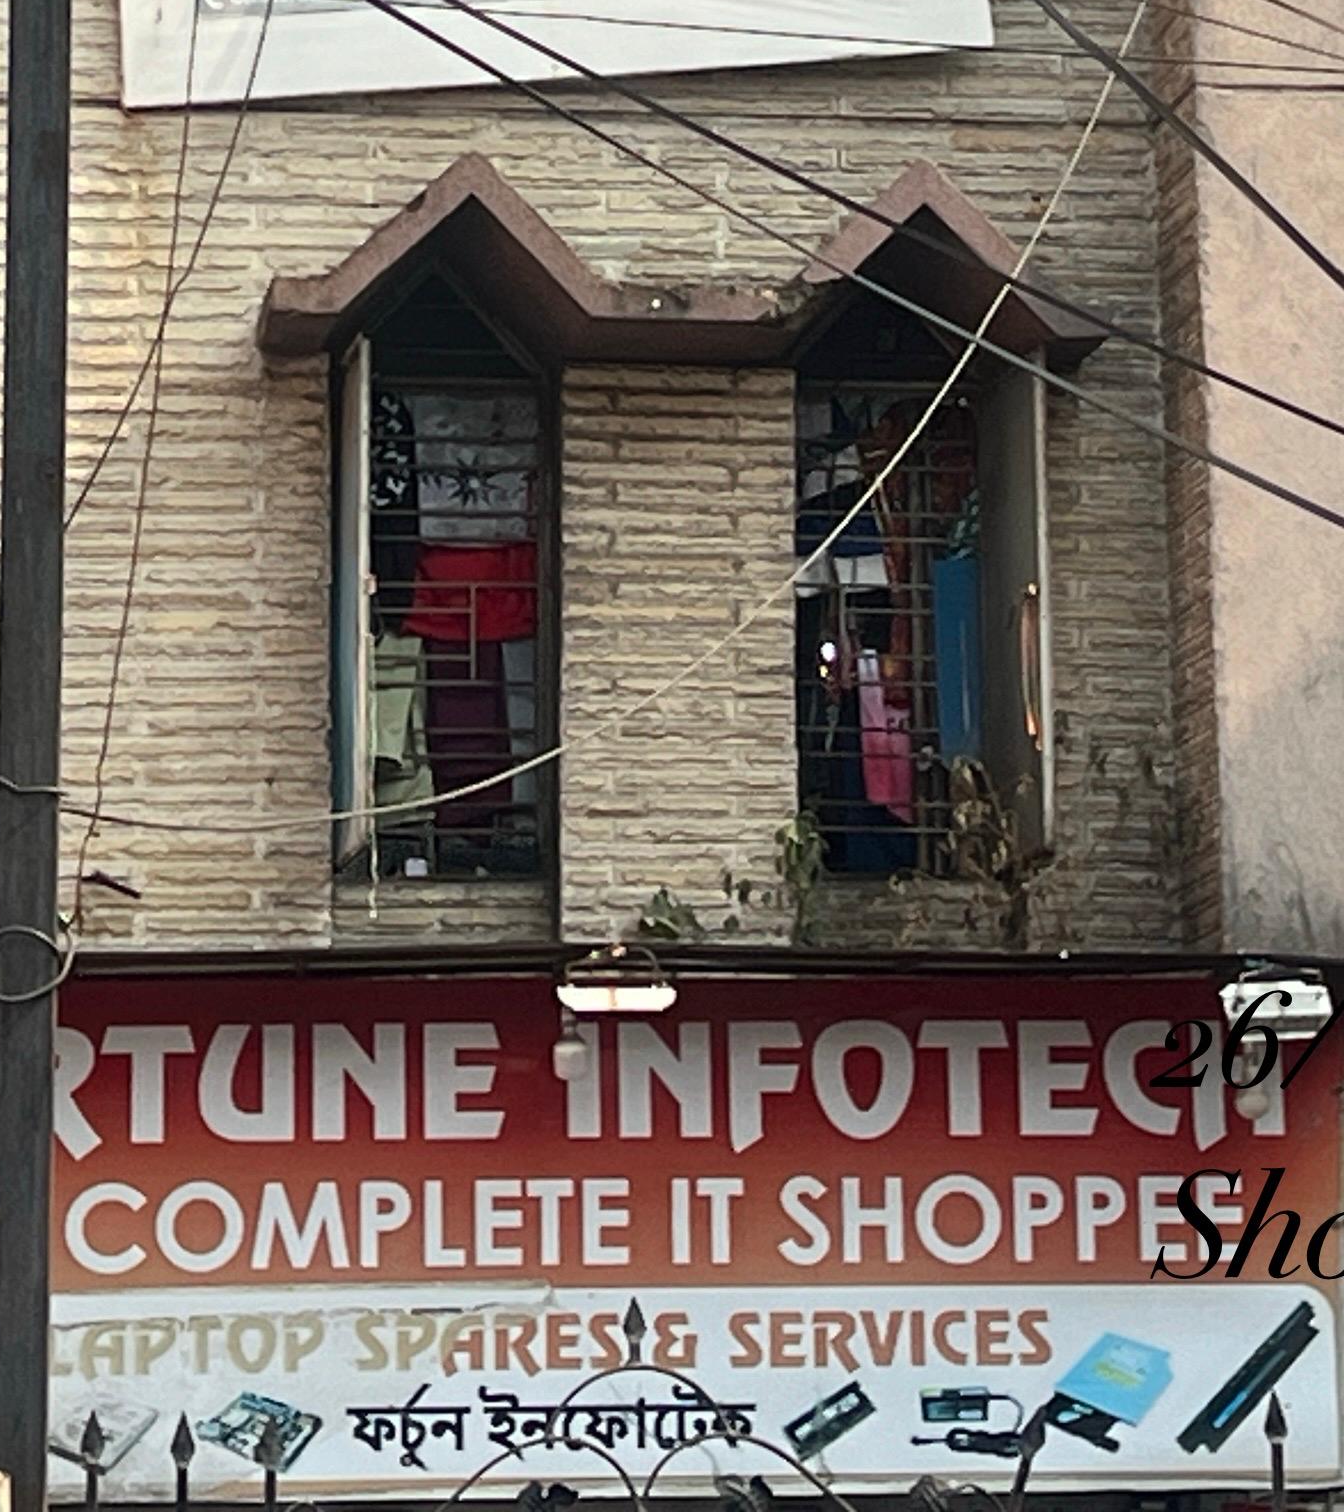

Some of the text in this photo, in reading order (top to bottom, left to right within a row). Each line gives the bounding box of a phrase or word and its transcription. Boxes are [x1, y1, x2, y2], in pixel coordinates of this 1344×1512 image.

[567, 1020, 1286, 1151] INFOTECH
[64, 1178, 630, 1273] COMPLETE
[670, 1178, 744, 1264] IT
[777, 1174, 1244, 1268] SHOPPEE
[355, 1308, 626, 1375] SPARES
[654, 1314, 698, 1368] &
[728, 1308, 1054, 1373] SERVICES
